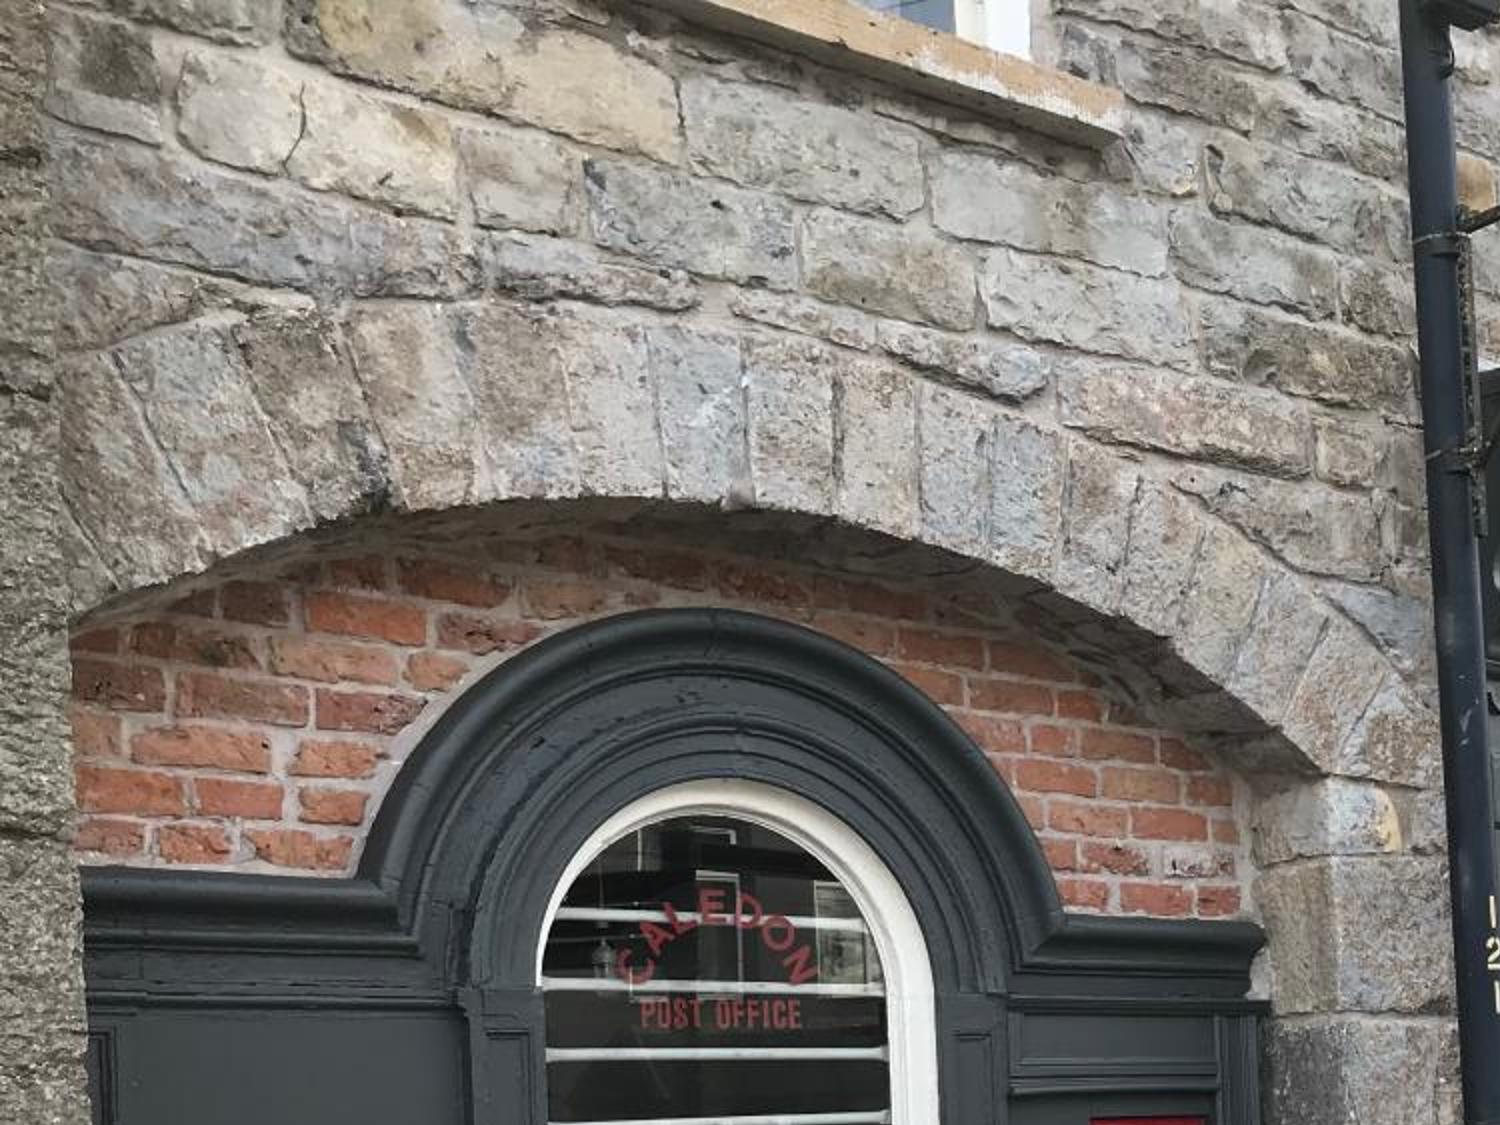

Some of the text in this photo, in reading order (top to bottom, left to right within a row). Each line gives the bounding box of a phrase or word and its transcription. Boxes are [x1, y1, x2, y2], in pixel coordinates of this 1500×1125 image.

[617, 888, 821, 985] CALEDON
[640, 999, 803, 1030] POST OFFICE
